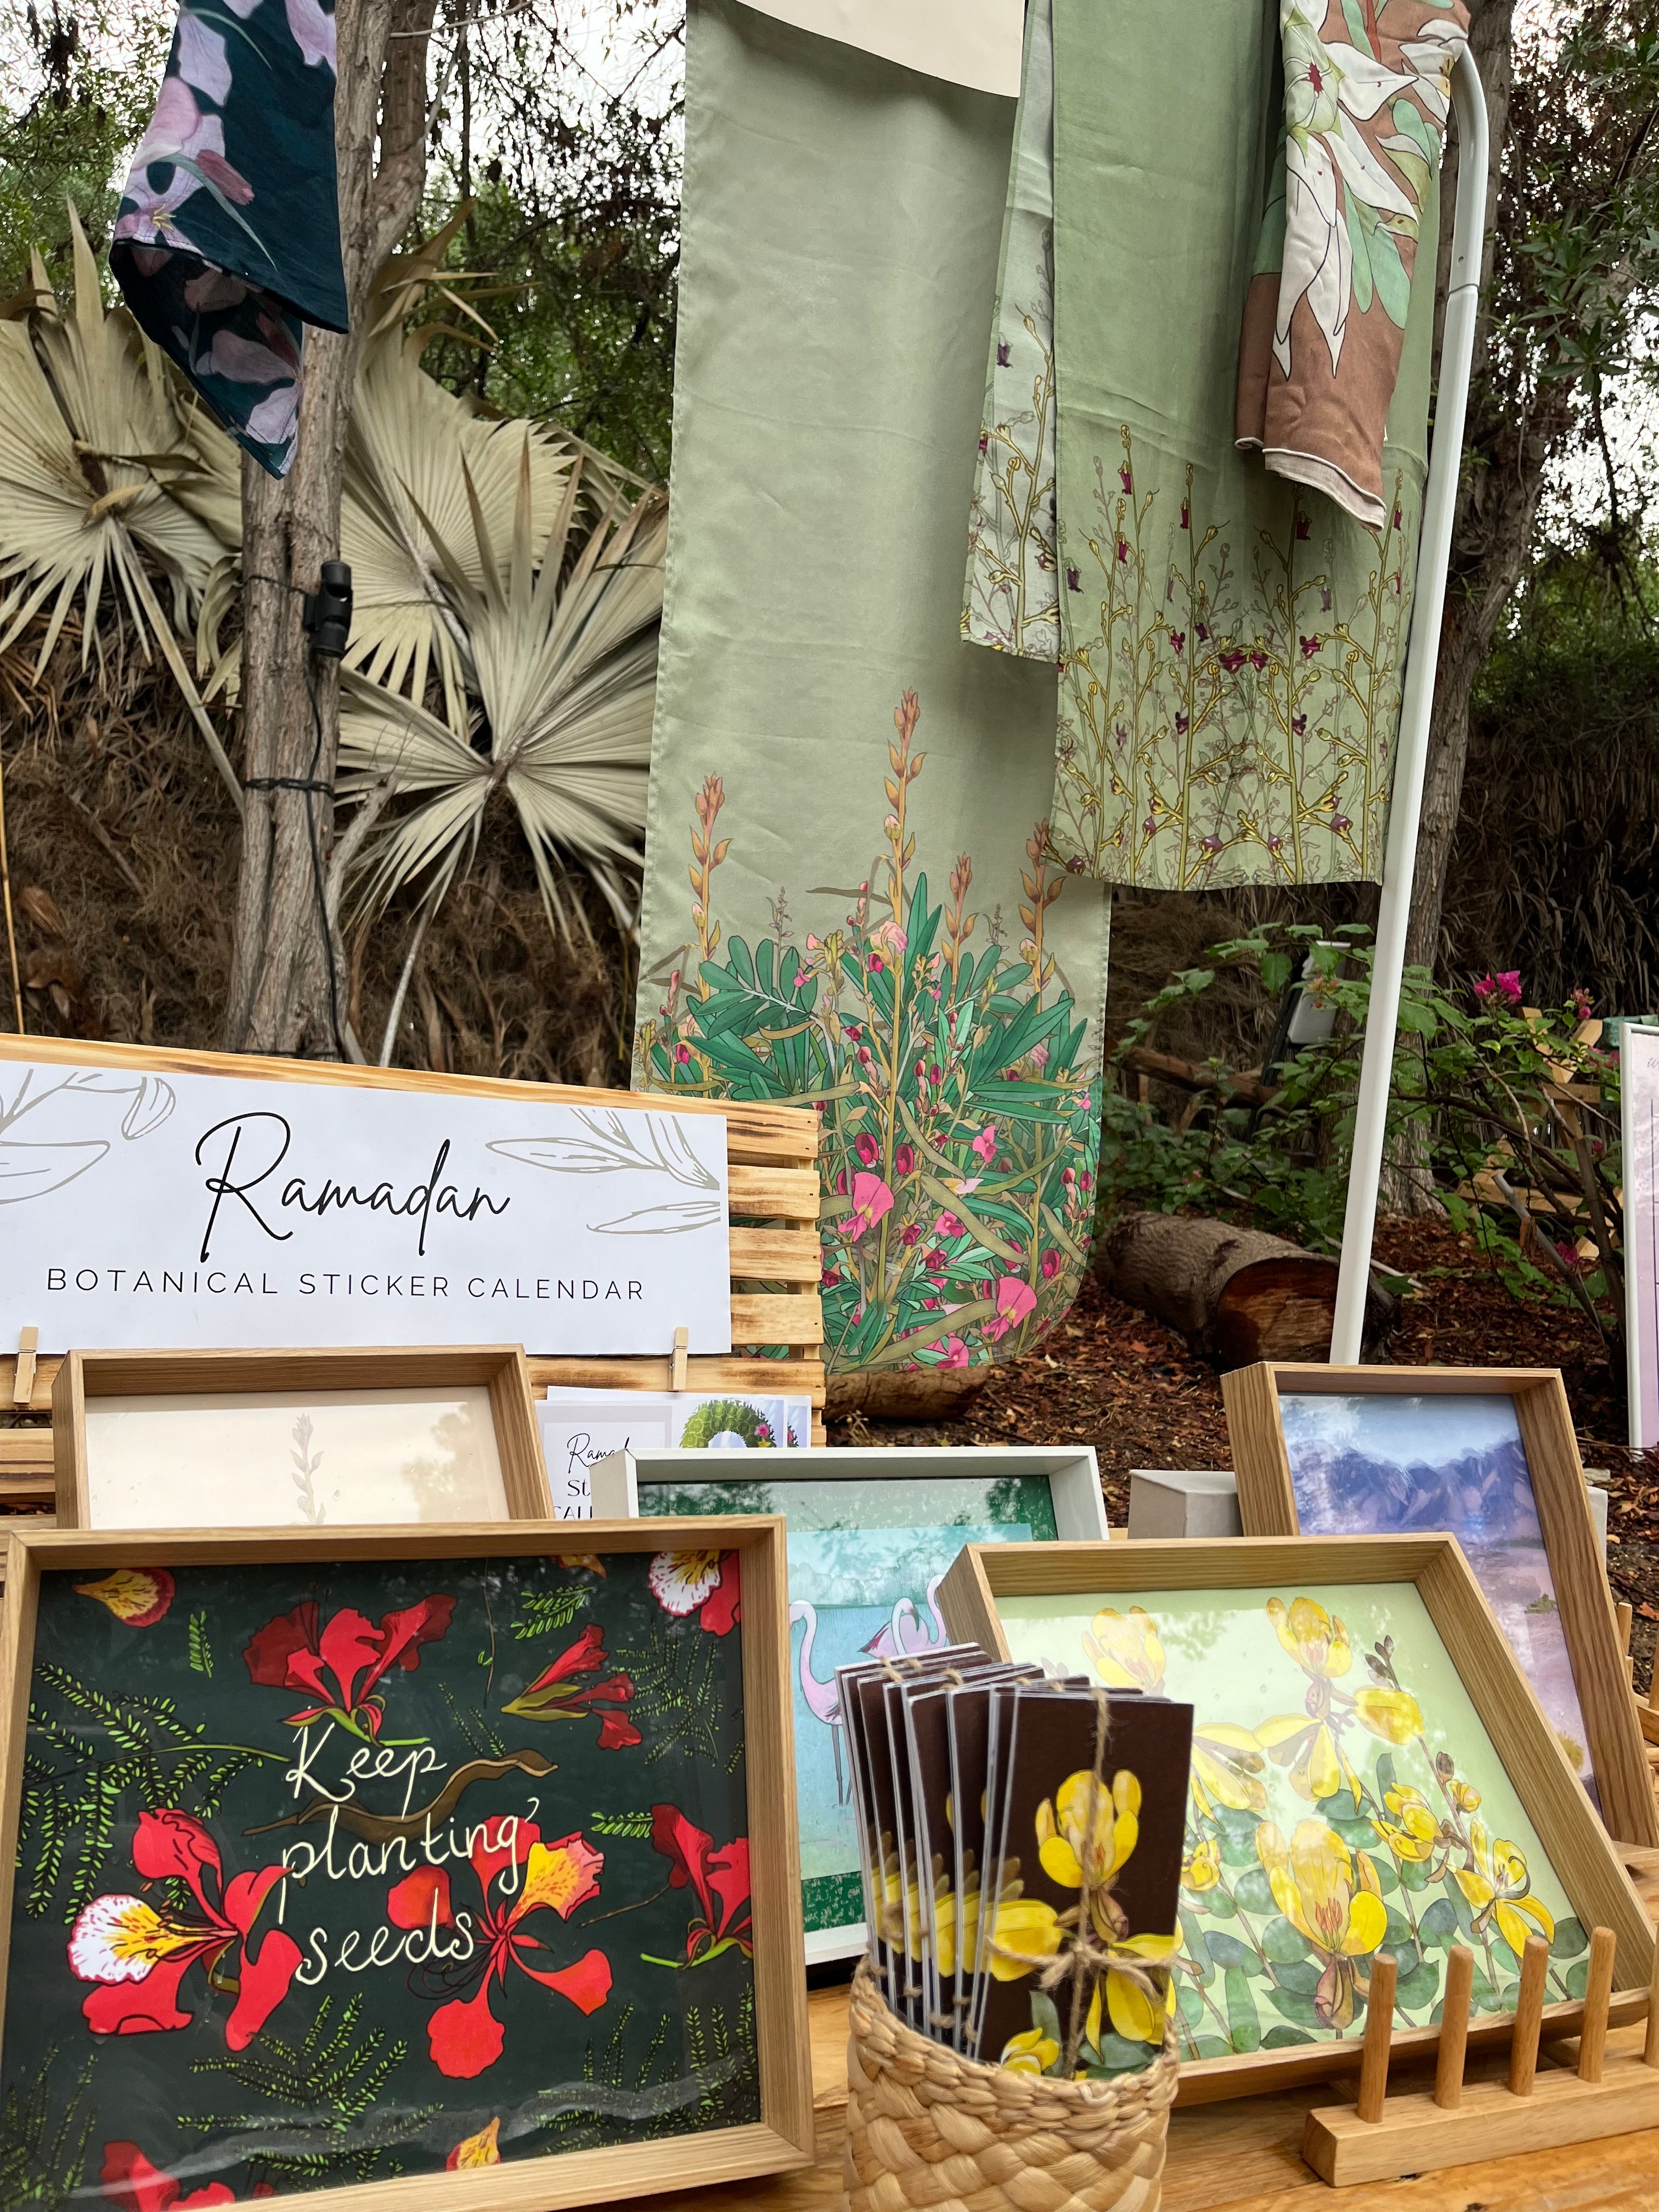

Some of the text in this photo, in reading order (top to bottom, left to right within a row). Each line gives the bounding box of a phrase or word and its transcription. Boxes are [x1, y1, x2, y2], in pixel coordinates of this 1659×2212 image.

[195, 1111, 511, 1263] Ramadan
[47, 1267, 644, 1300] BOTANICAL STICKER CALENDAR
[285, 1721, 447, 1820] Keep
[278, 1796, 540, 1925] planting
[295, 1887, 475, 1985] seeds
